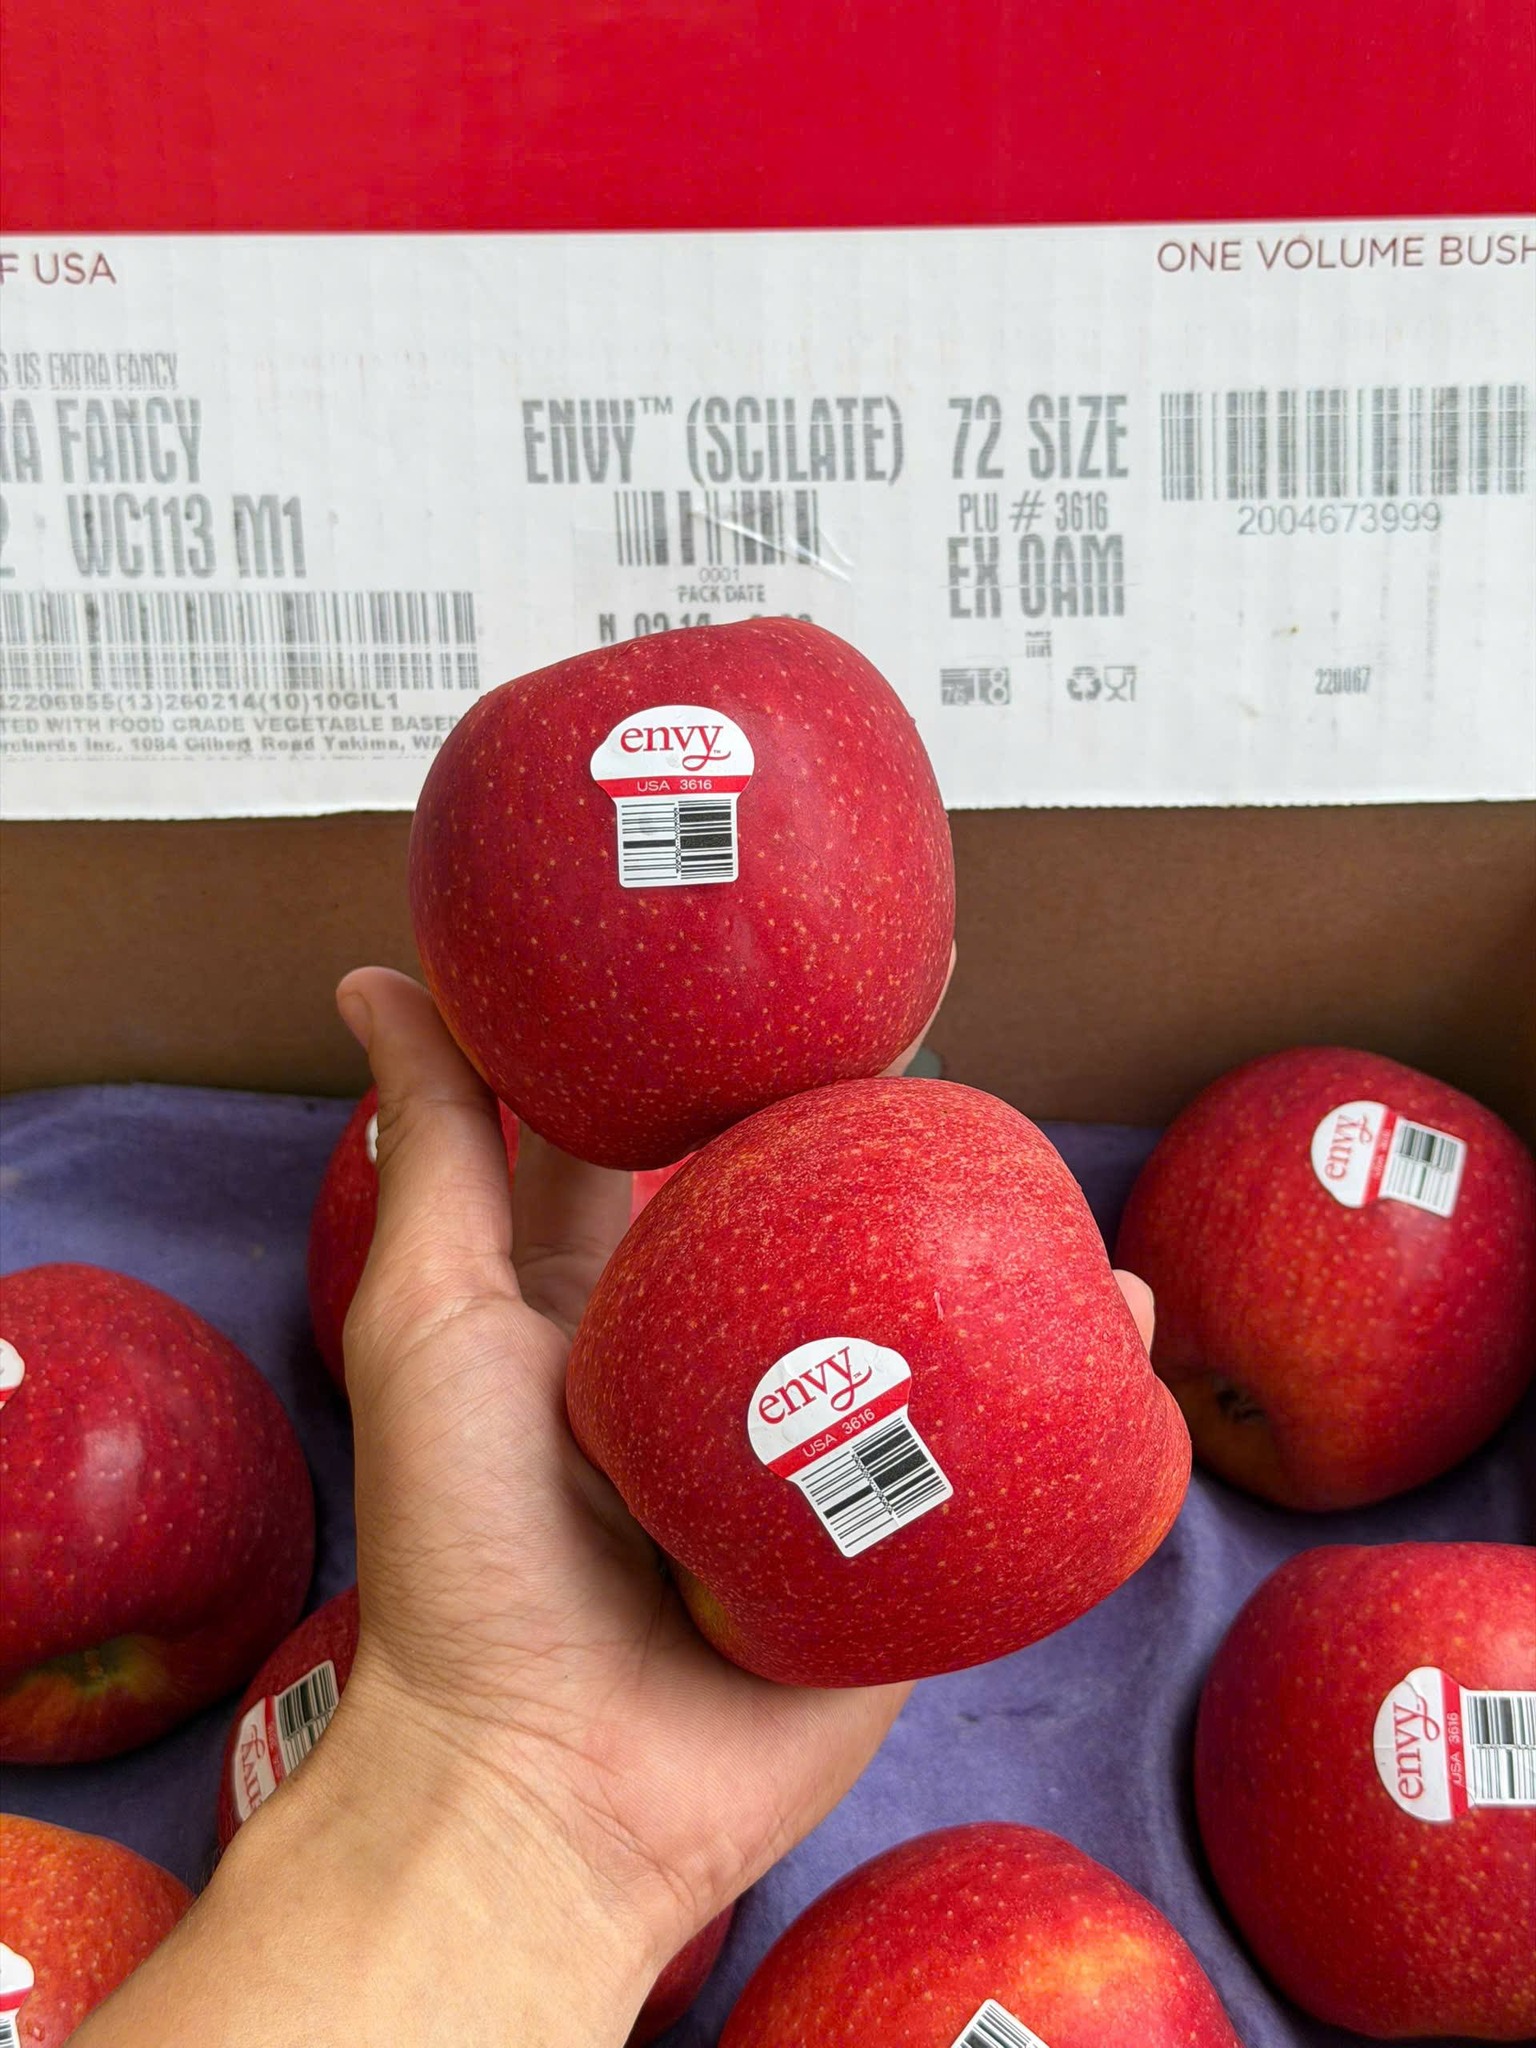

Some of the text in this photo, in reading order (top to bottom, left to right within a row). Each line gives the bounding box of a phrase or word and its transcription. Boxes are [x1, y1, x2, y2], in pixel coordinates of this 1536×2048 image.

[33, 253, 117, 286] USA
[1157, 241, 1242, 272] ONE
[1257, 237, 1425, 270] VOLUME
[116, 352, 178, 391] FANCY
[55, 396, 202, 484] FANCY
[685, 396, 905, 487] (SCILATE)
[948, 393, 1129, 481] 72 SIZE
[958, 490, 1109, 533] PLU # 3616
[1237, 501, 1442, 536] 2004673999
[67, 492, 217, 580] WC113
[232, 494, 308, 579] M1
[677, 584, 767, 604] PACK DATE
[948, 535, 1003, 620] EX
[45, 716, 101, 733] WITH
[109, 716, 165, 733] FOOD
[172, 716, 245, 733] GRADE
[253, 716, 384, 733] VEGETABLE
[636, 779, 713, 792] USA 3616
[1324, 1112, 1373, 1181] envy
[801, 1407, 876, 1458] USA 3616
[1446, 1712, 1464, 1786] USA 3616
